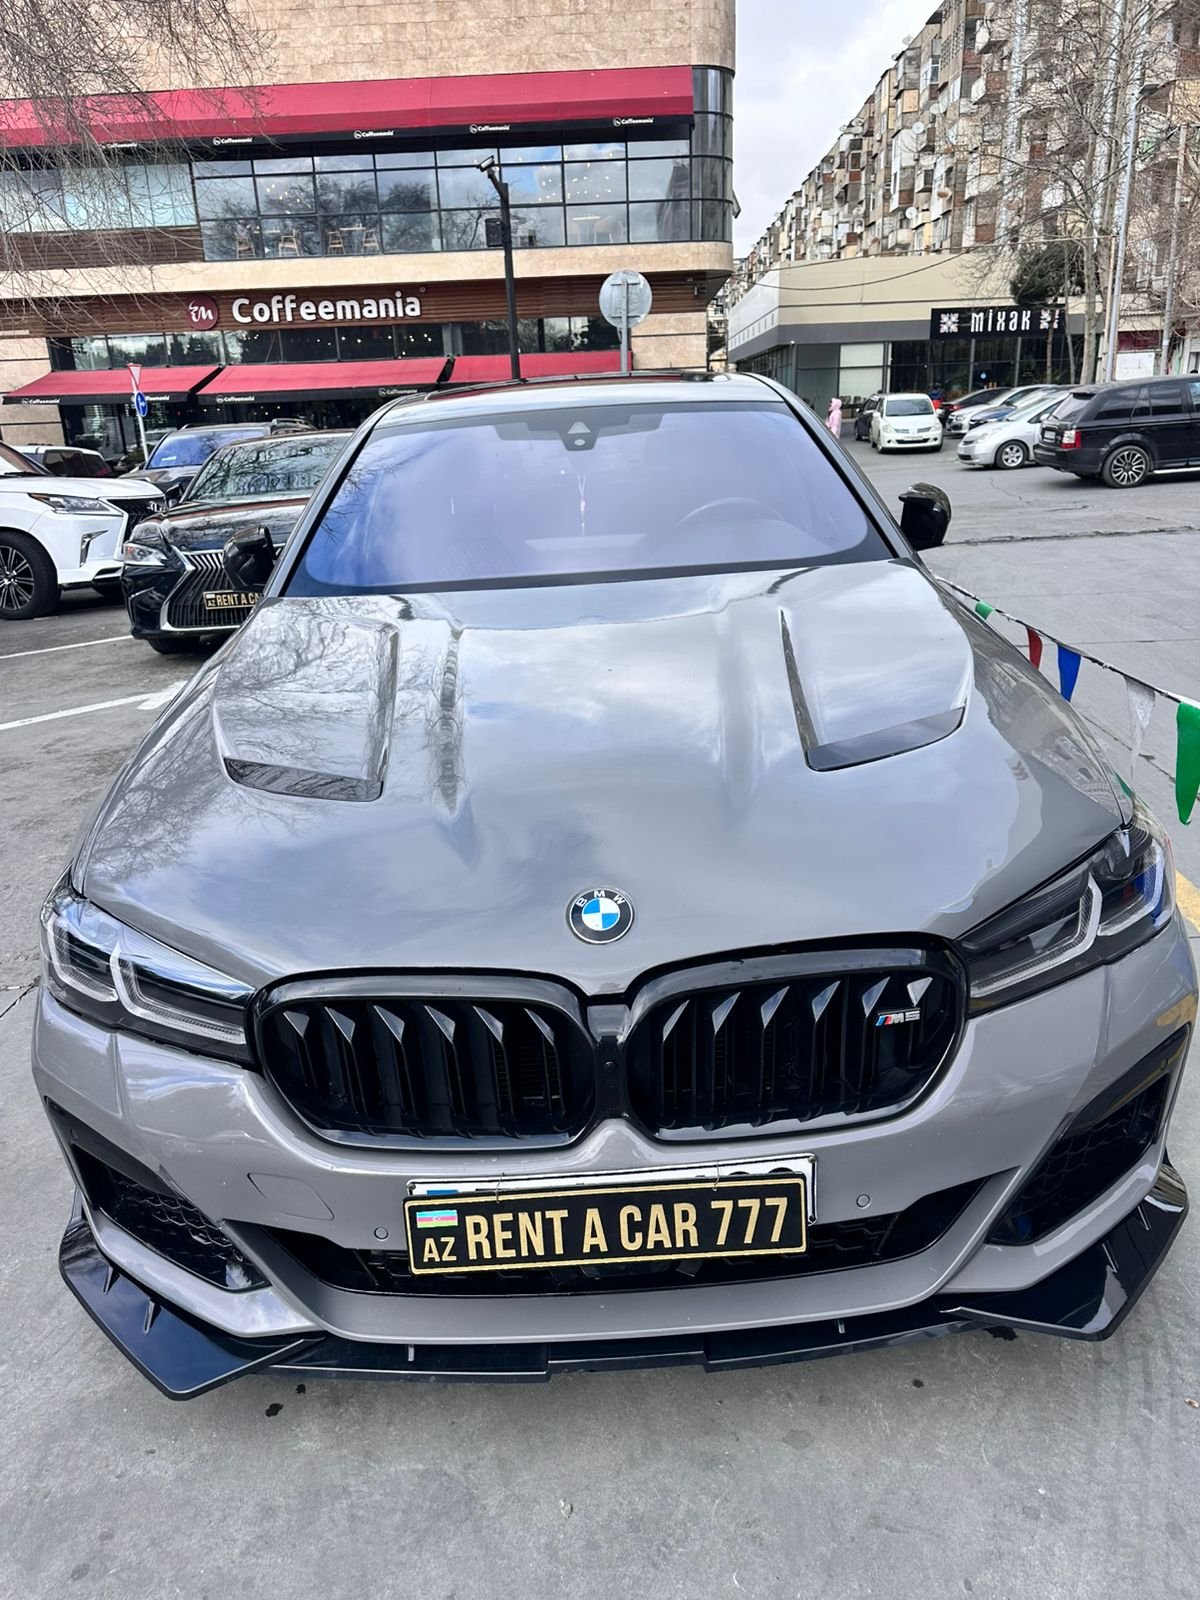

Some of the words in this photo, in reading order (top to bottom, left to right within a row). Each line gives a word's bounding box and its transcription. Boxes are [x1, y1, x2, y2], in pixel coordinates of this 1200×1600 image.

[231, 290, 421, 324] Coffeemania
[216, 594, 239, 606] RENT
[240, 593, 248, 605] A
[575, 889, 626, 907] BMW
[423, 1236, 457, 1263] AZ
[465, 1209, 569, 1261] RENT
[582, 1207, 608, 1254] A
[619, 1202, 700, 1251] CAR
[710, 1196, 789, 1246] 777
